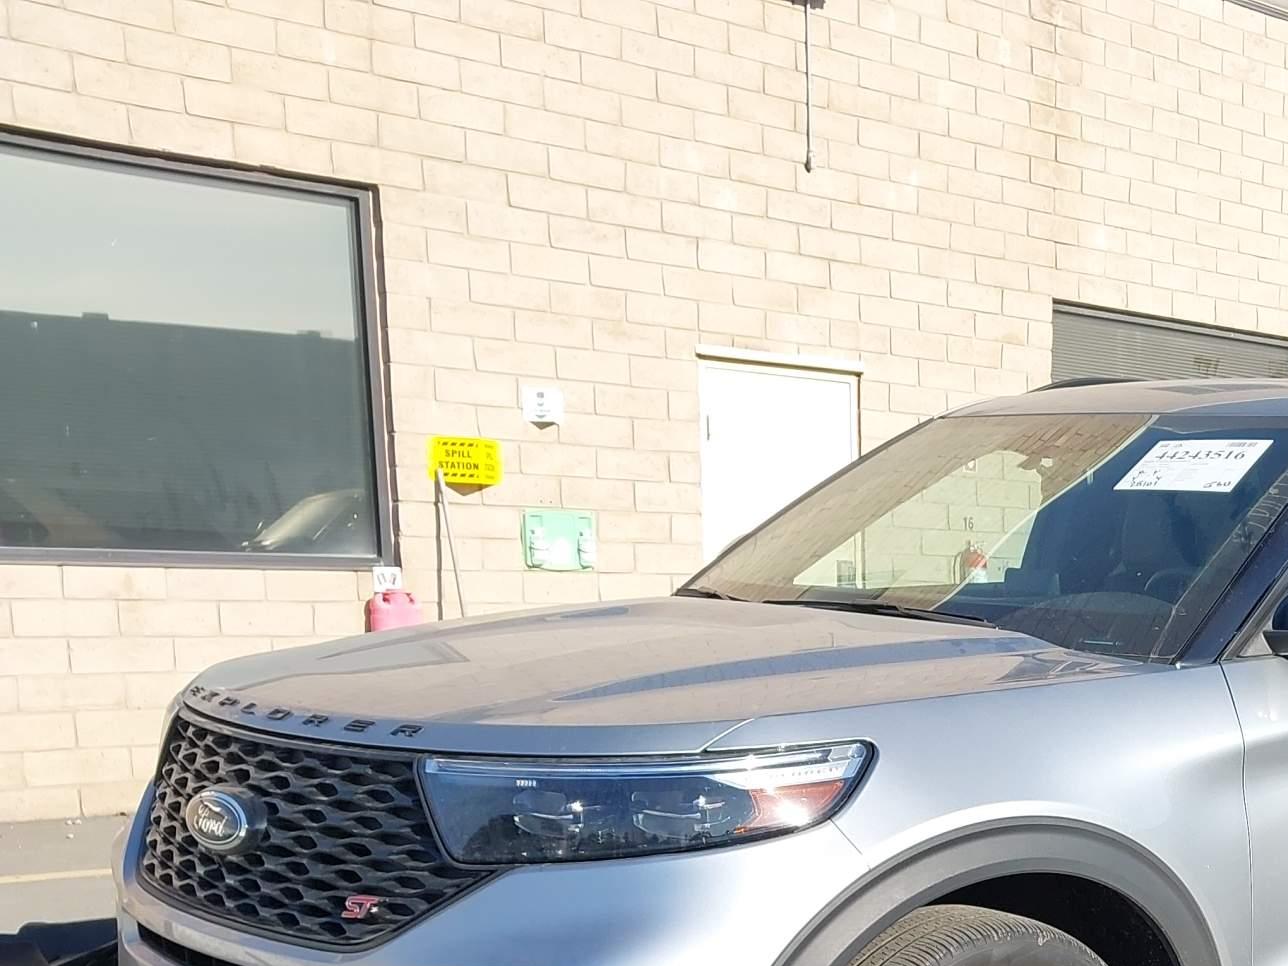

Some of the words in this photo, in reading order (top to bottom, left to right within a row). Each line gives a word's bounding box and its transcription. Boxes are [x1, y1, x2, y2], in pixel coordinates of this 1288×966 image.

[445, 449, 472, 458] SPILL
[1155, 450, 1246, 460] 44243516
[438, 461, 479, 470] STATION
[963, 516, 974, 530] 16
[189, 685, 425, 738] EXPLORER
[193, 801, 226, 837] Ford
[341, 895, 380, 919] ST
